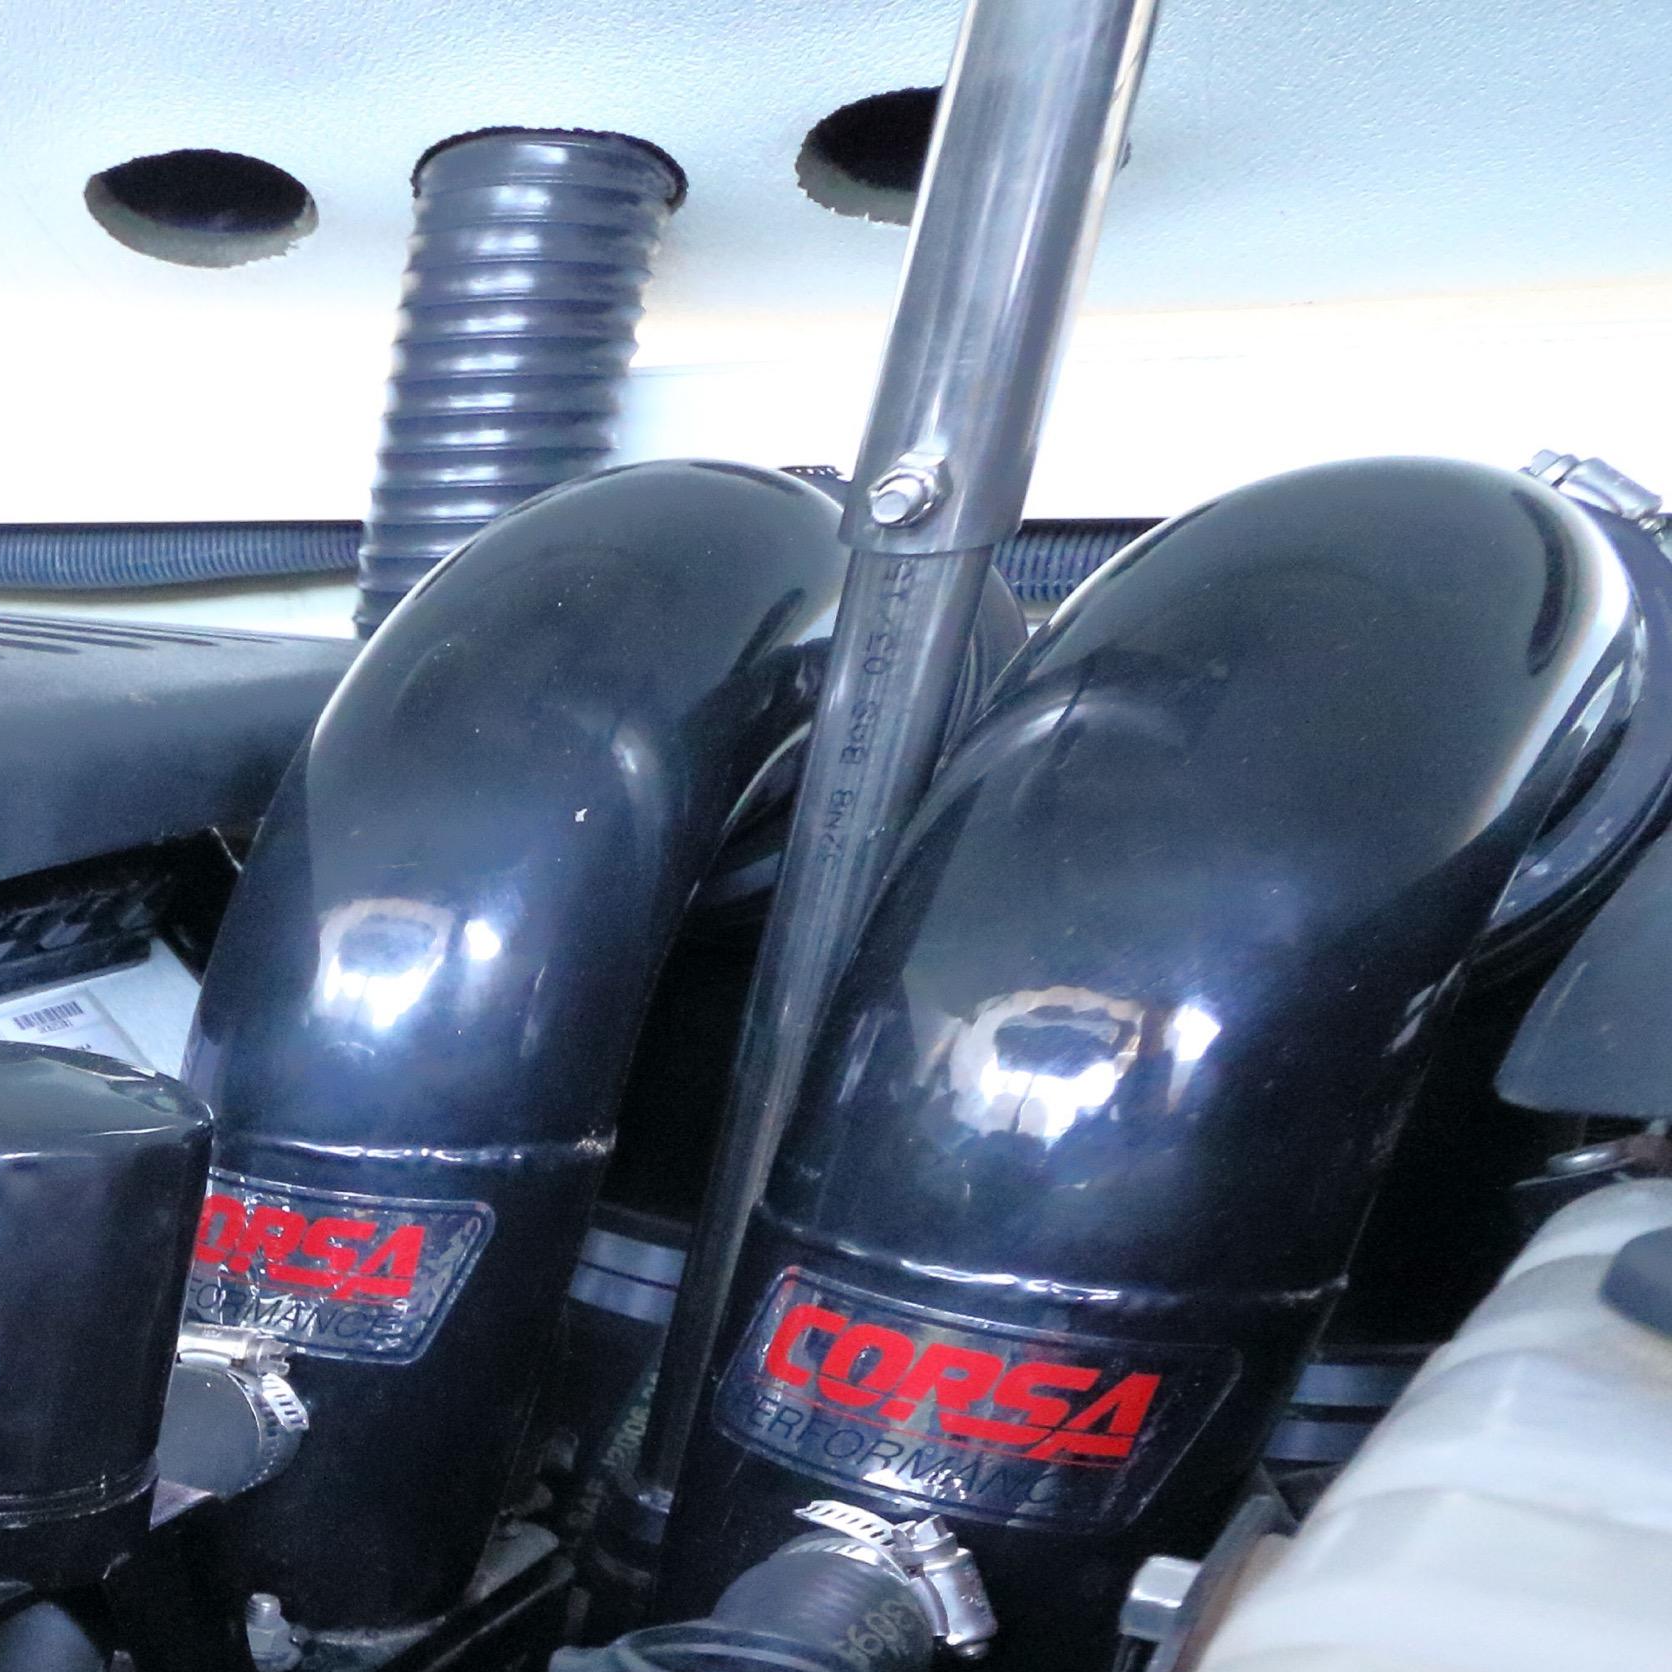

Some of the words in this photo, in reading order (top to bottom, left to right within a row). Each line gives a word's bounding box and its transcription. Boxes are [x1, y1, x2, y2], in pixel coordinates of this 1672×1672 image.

[194, 1193, 426, 1300] ORSA
[189, 1277, 406, 1340] ORMANCE
[765, 1304, 1162, 1460] CORSA
